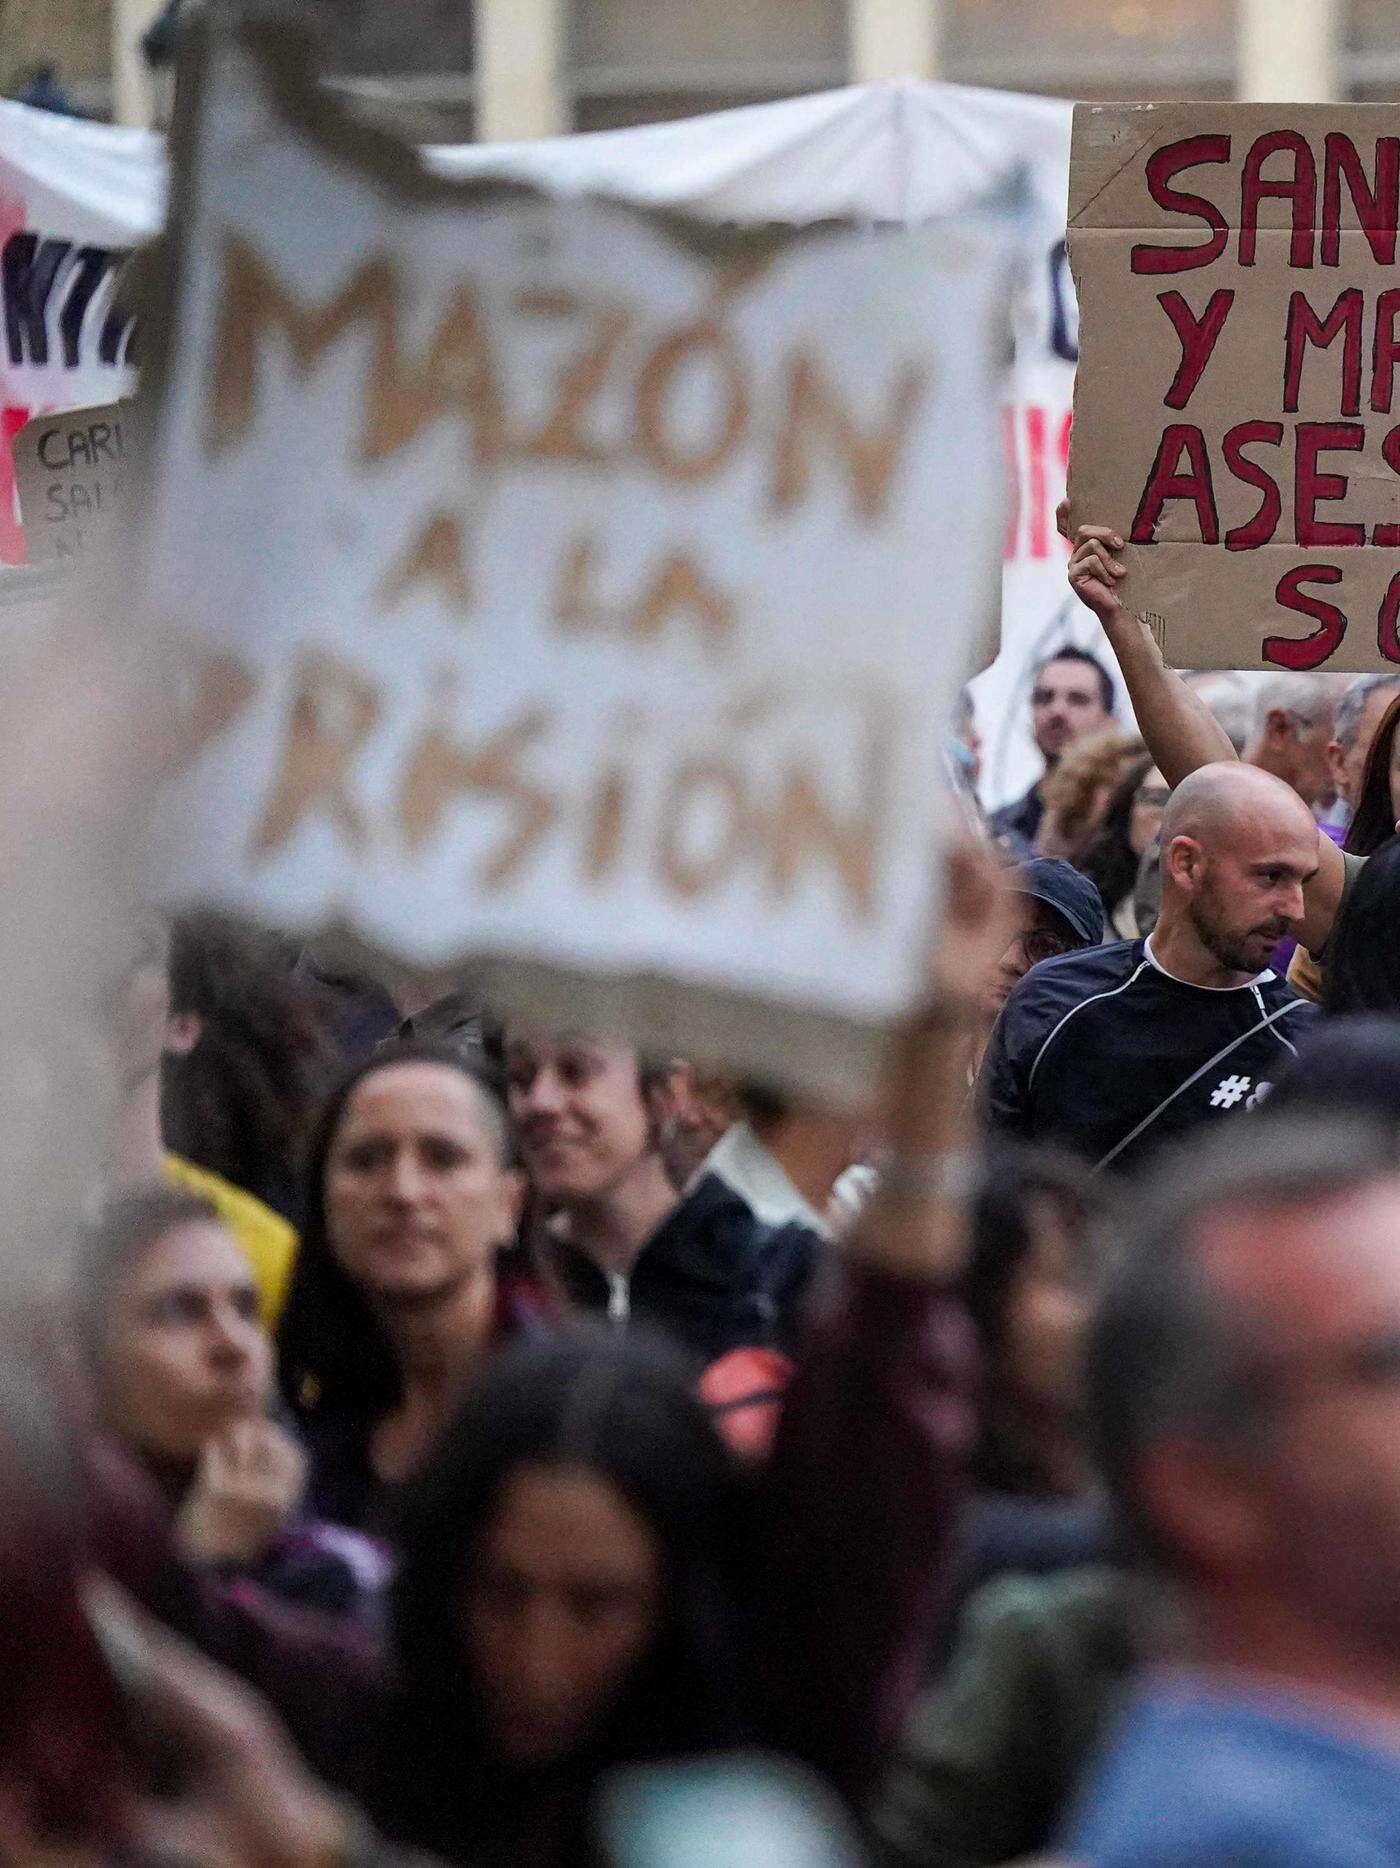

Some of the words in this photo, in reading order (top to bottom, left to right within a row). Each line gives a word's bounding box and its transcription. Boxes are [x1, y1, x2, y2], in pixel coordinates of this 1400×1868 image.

[203, 235, 935, 525] MAZÓN
[1157, 288, 1235, 410] Y
[552, 528, 736, 652] LA
